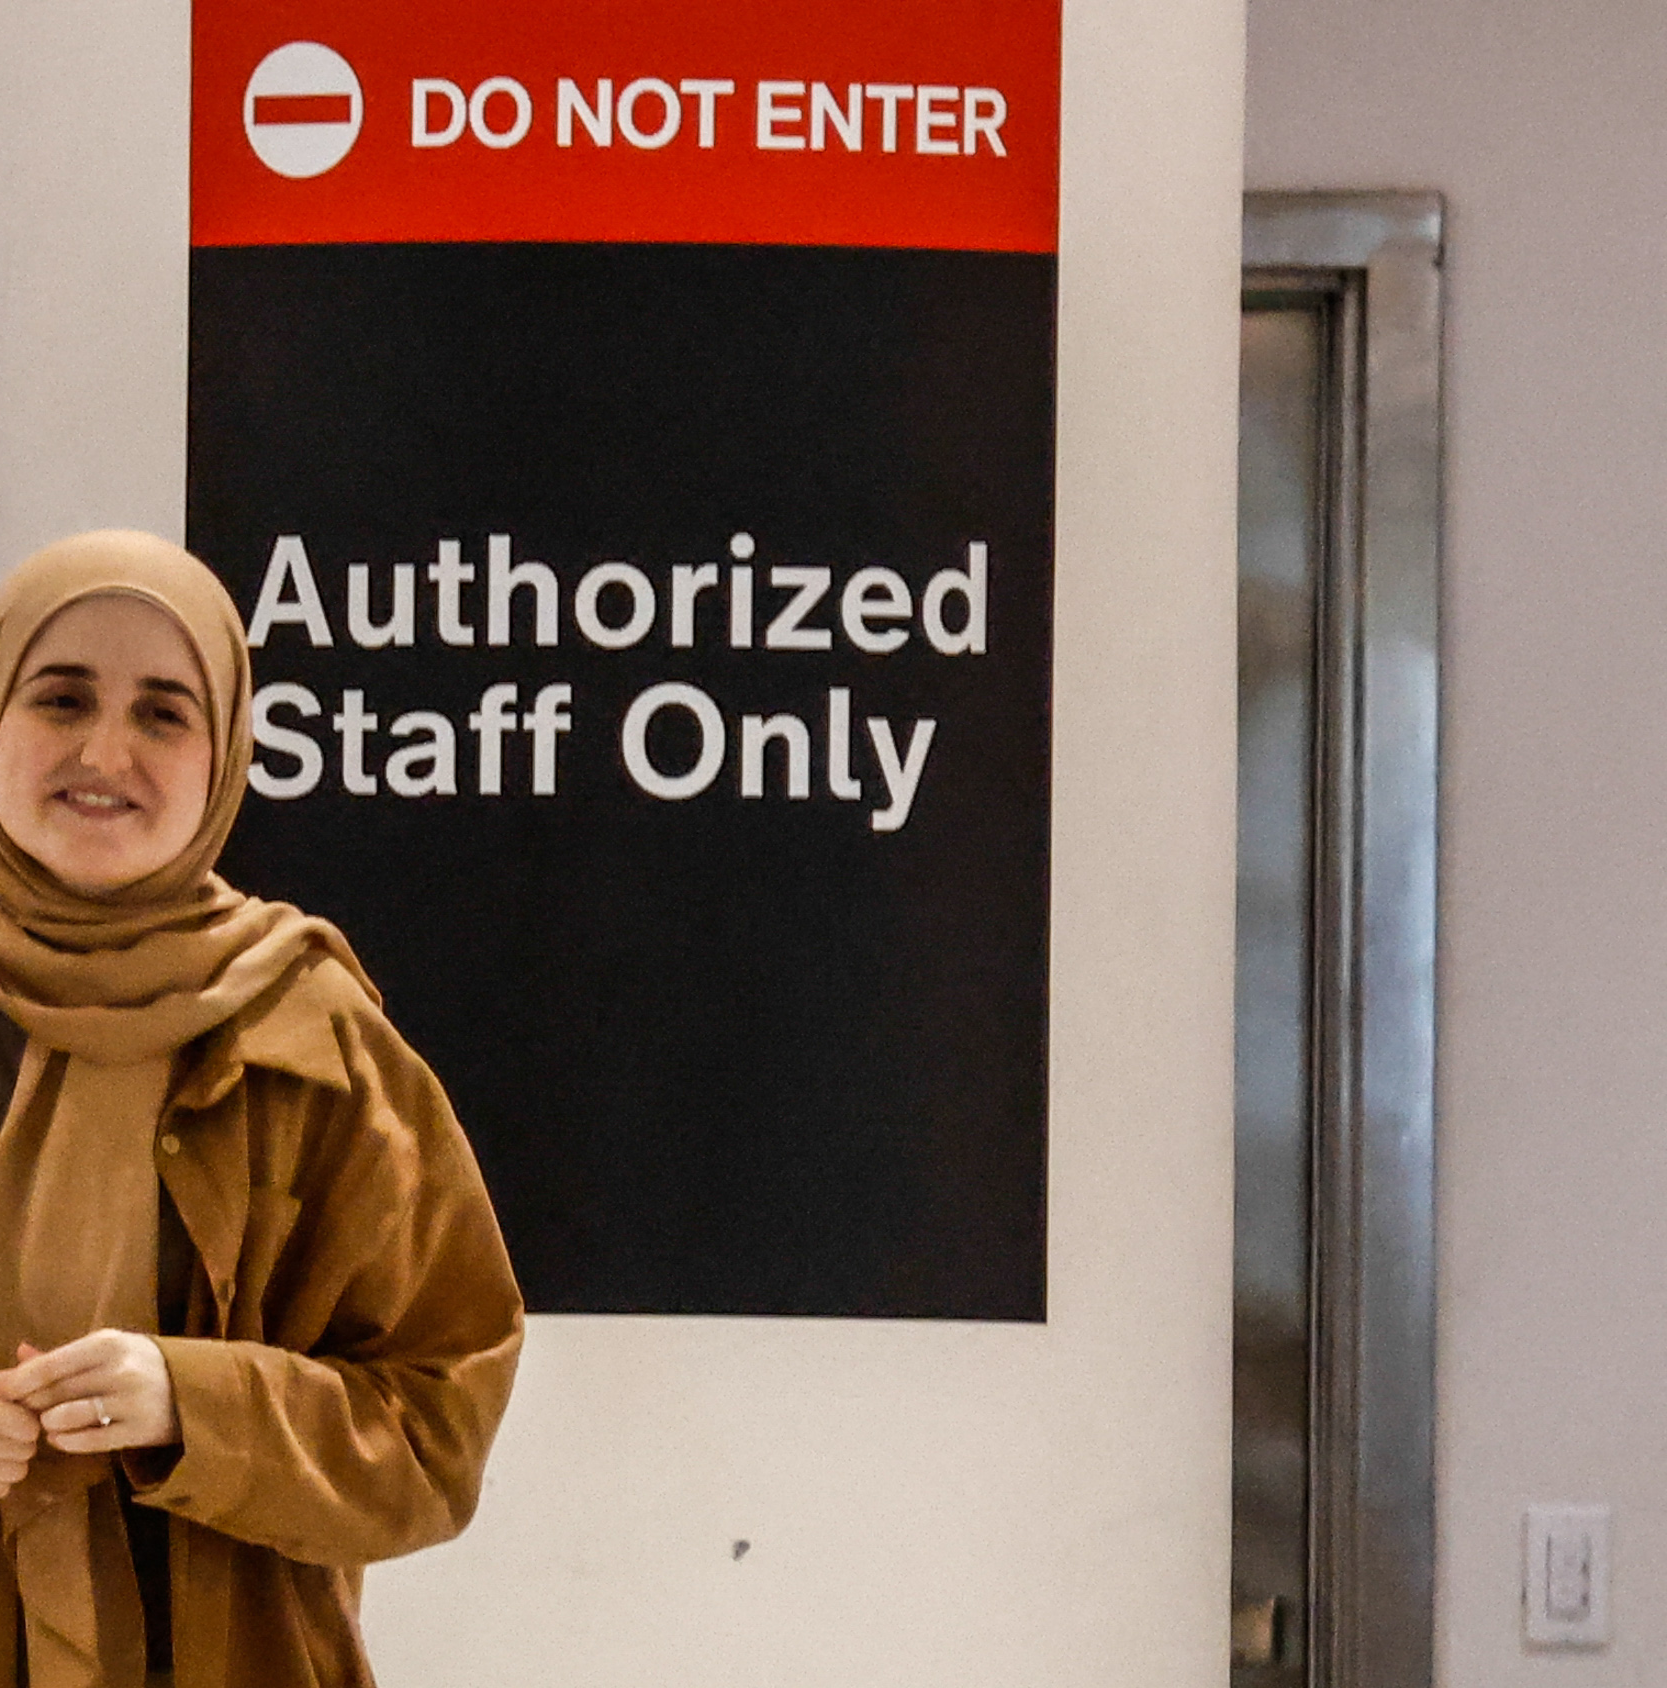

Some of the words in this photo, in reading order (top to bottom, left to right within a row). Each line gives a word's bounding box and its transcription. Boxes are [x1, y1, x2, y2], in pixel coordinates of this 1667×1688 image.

[411, 76, 532, 148] DO
[557, 77, 735, 149] NOT
[756, 80, 1007, 157] ENTER
[247, 532, 988, 652] Authorized
[247, 682, 572, 799] Staff
[622, 682, 937, 831] Only
